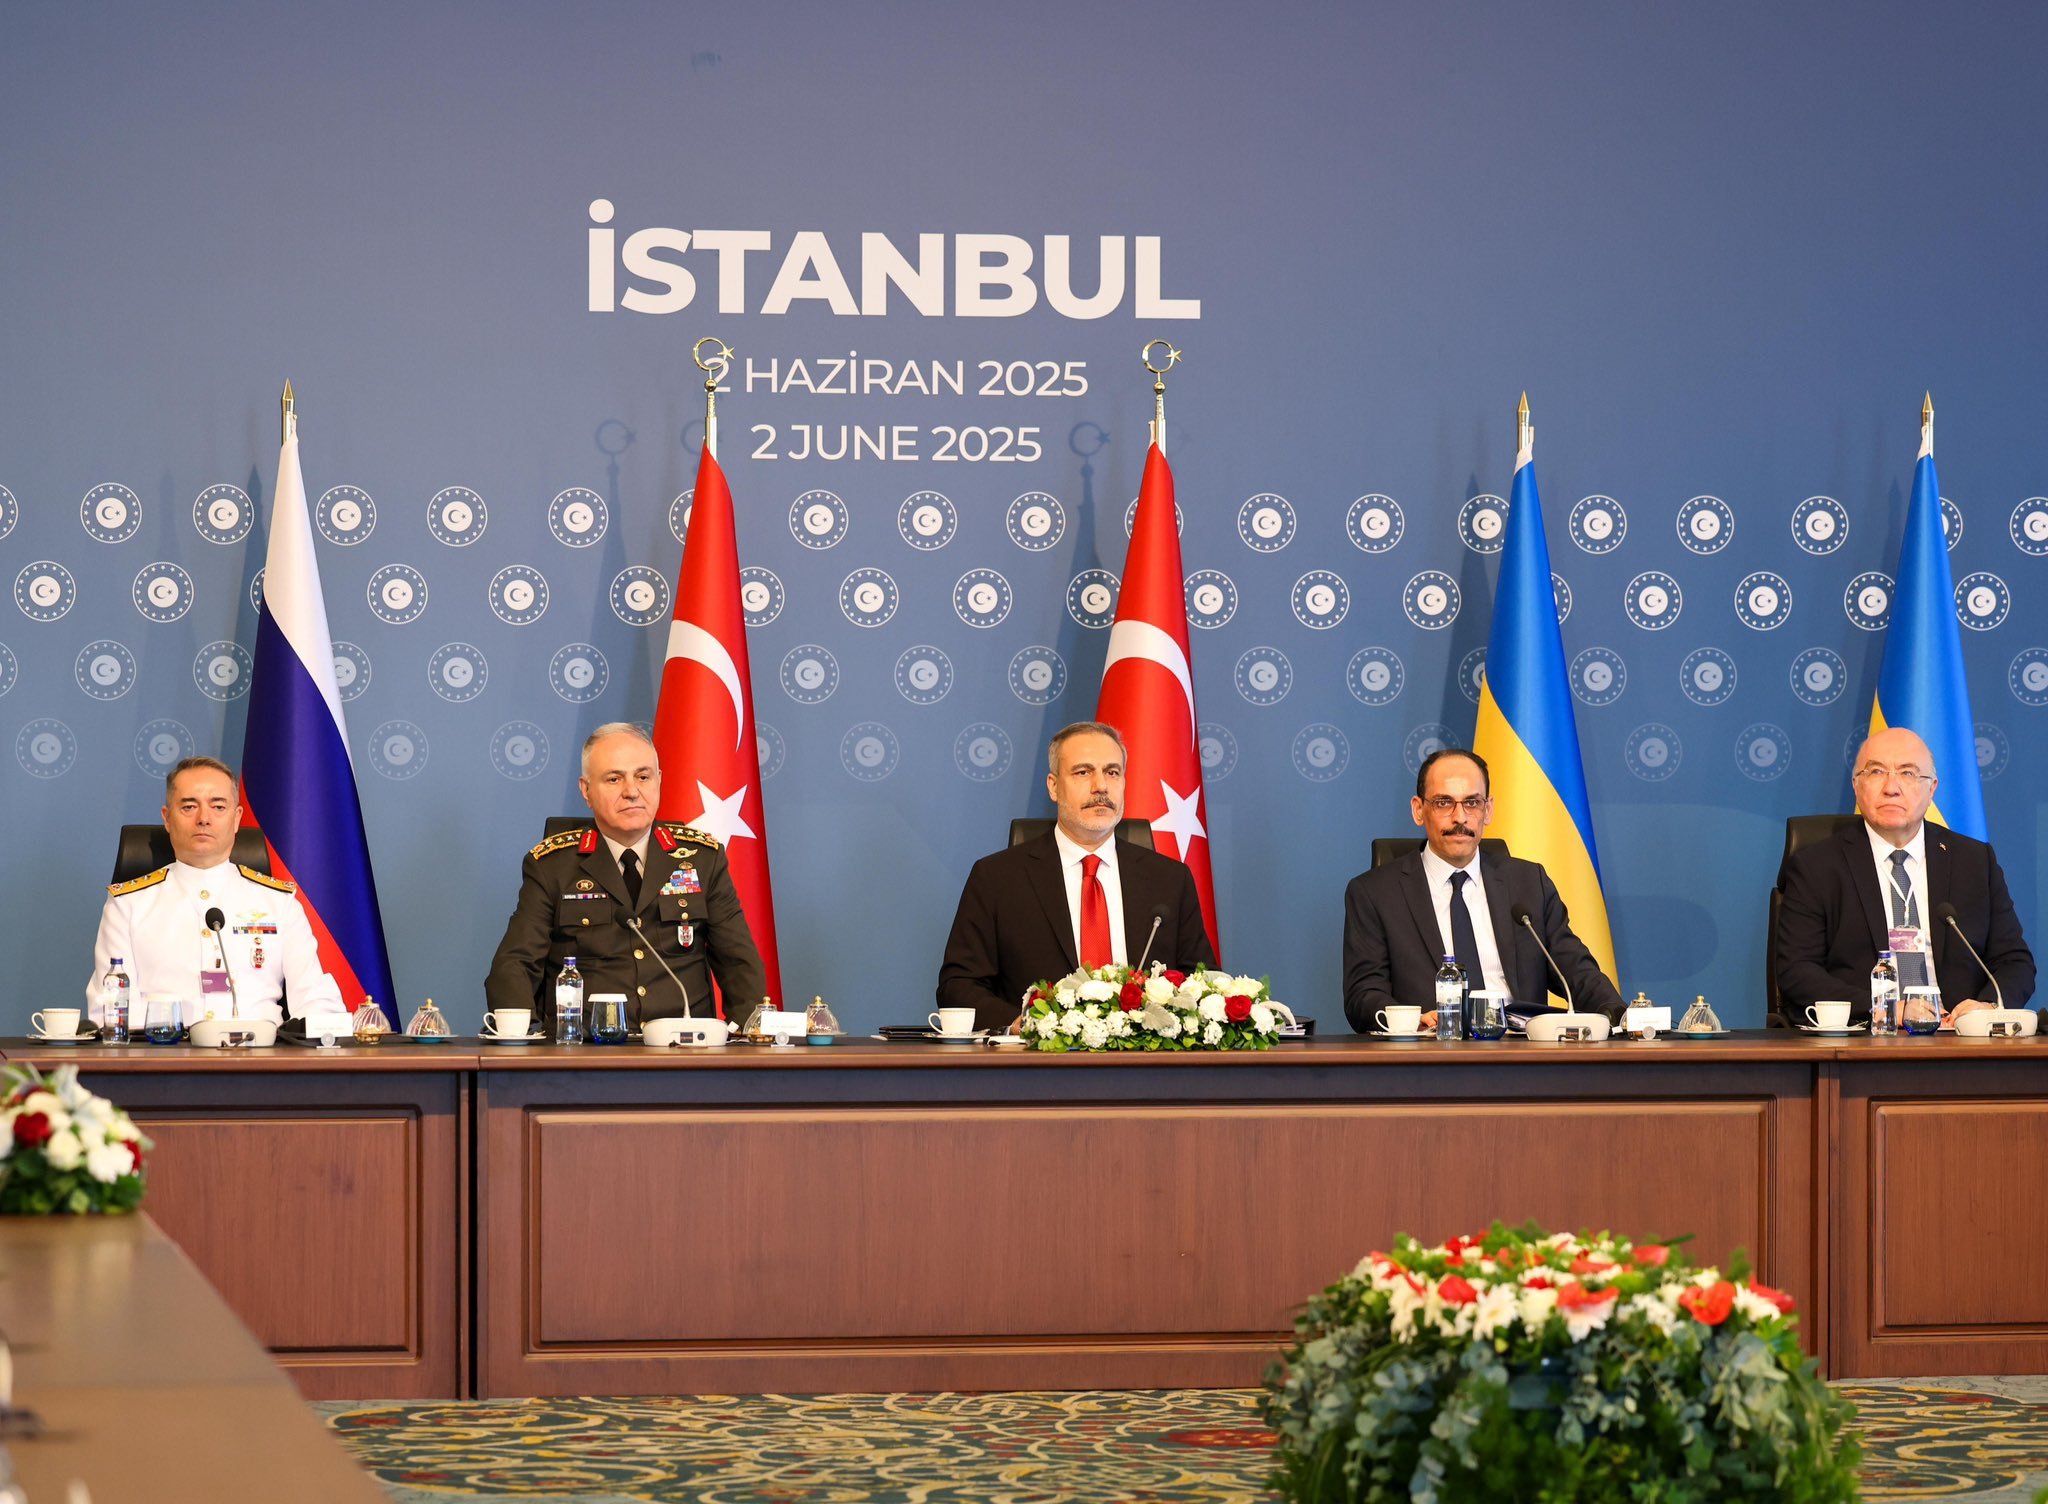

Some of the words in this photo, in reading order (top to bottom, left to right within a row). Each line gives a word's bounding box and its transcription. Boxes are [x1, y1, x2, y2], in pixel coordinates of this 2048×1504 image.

[588, 199, 1201, 320] İSTANBUL
[704, 357, 731, 393] 2
[746, 351, 964, 396] HAZİRAN
[977, 360, 1089, 397] 2025
[750, 424, 778, 460] 2
[787, 424, 919, 461] JUNE
[931, 425, 1042, 462] 2025
